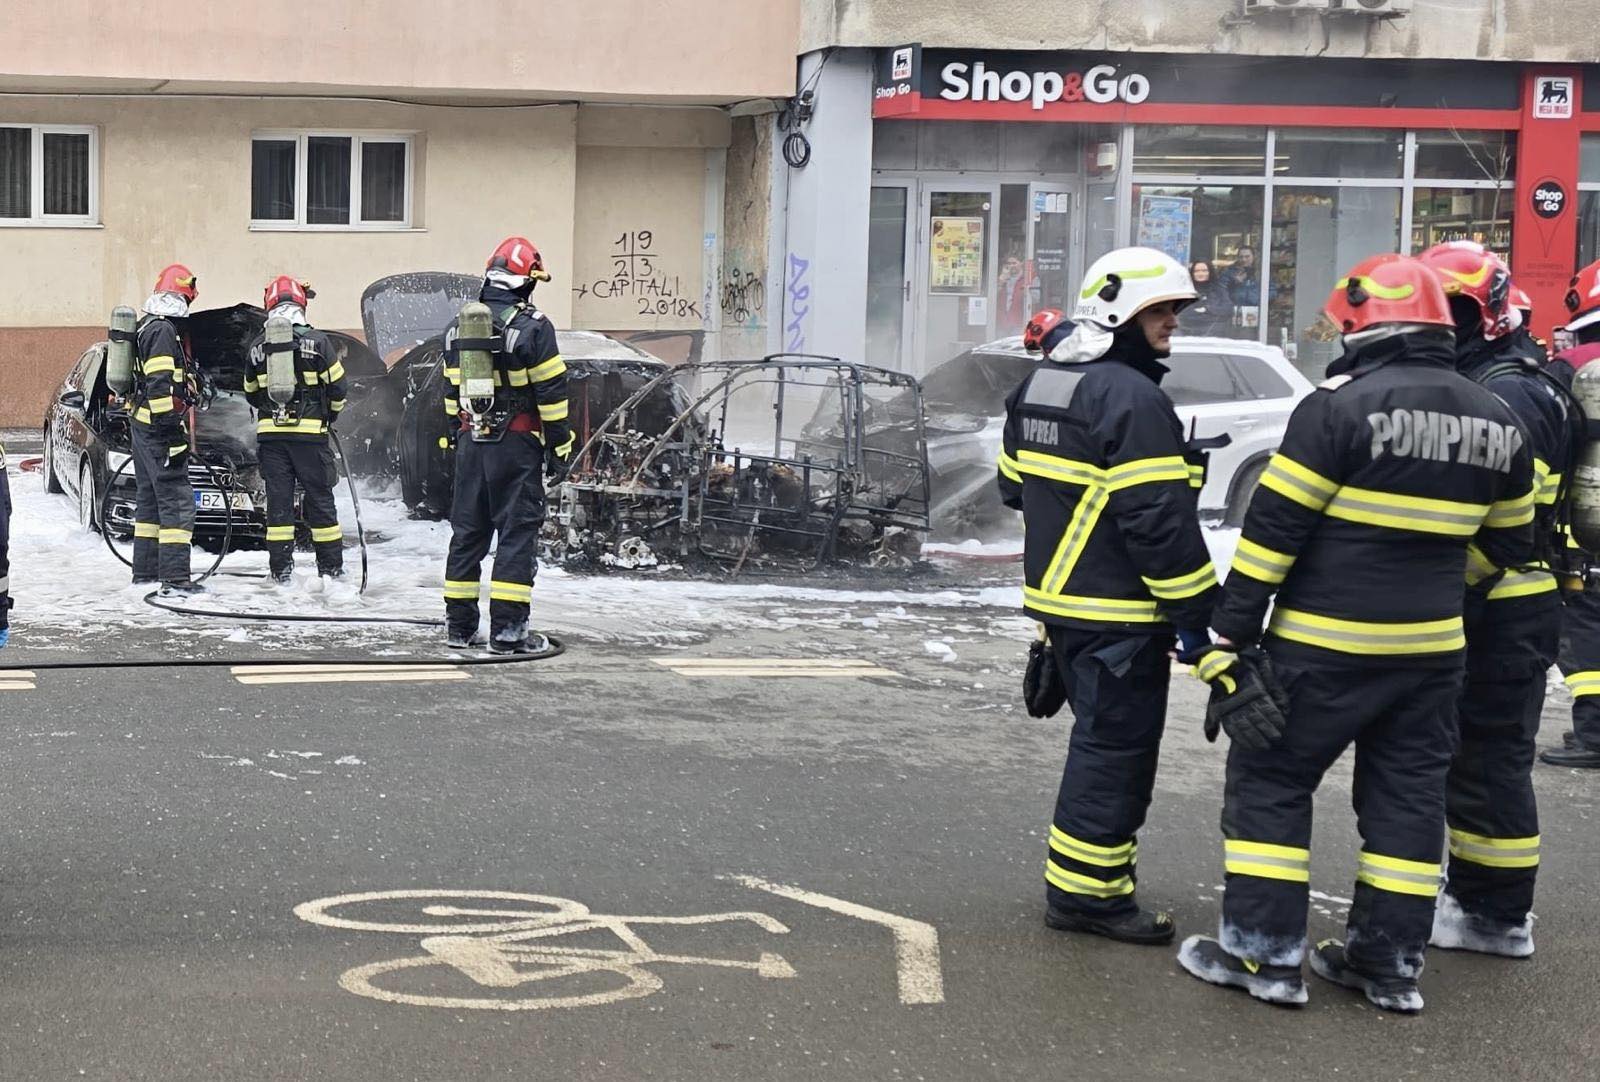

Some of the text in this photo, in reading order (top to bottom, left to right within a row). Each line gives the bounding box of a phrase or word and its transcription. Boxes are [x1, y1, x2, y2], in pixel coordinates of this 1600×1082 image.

[876, 83, 911, 99] Shop Go
[940, 62, 1150, 109] Shop&Go
[1535, 189, 1563, 201] Shop
[1023, 417, 1058, 445] OPREA
[202, 494, 221, 507] BZ
